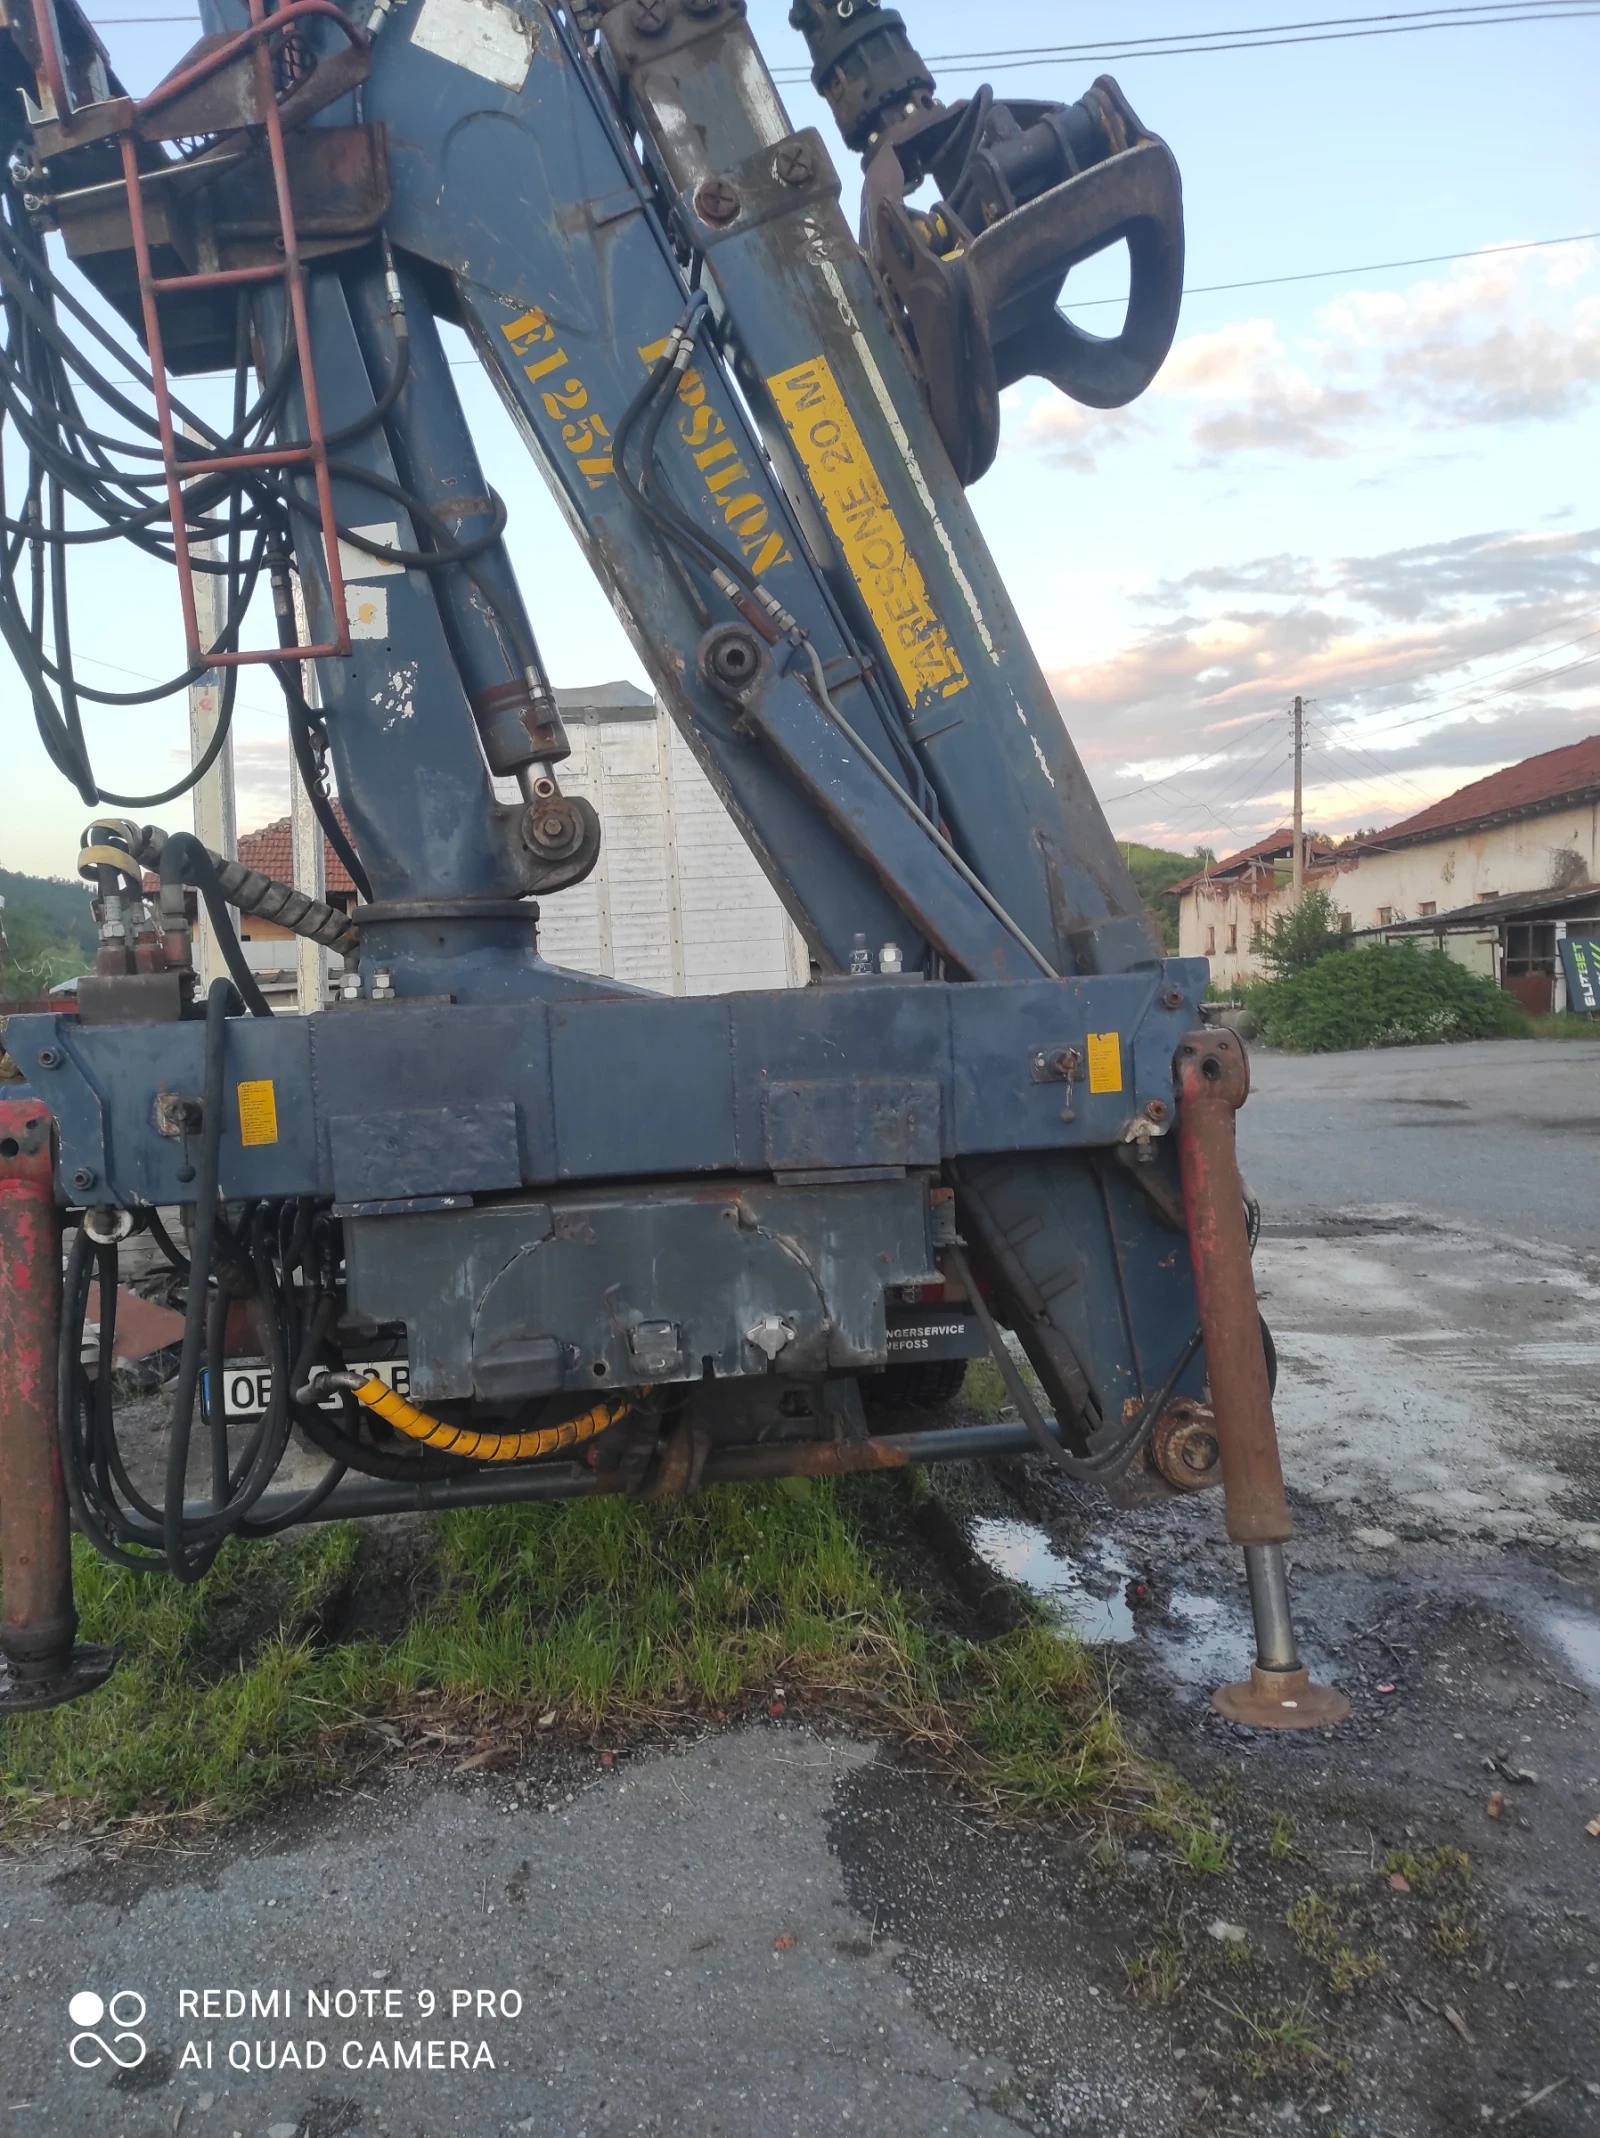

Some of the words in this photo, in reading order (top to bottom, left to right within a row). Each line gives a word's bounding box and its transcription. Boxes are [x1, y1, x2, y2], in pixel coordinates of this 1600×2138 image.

[785, 370, 827, 412] M
[809, 419, 855, 473] 20
[834, 478, 946, 690] ARESONE
